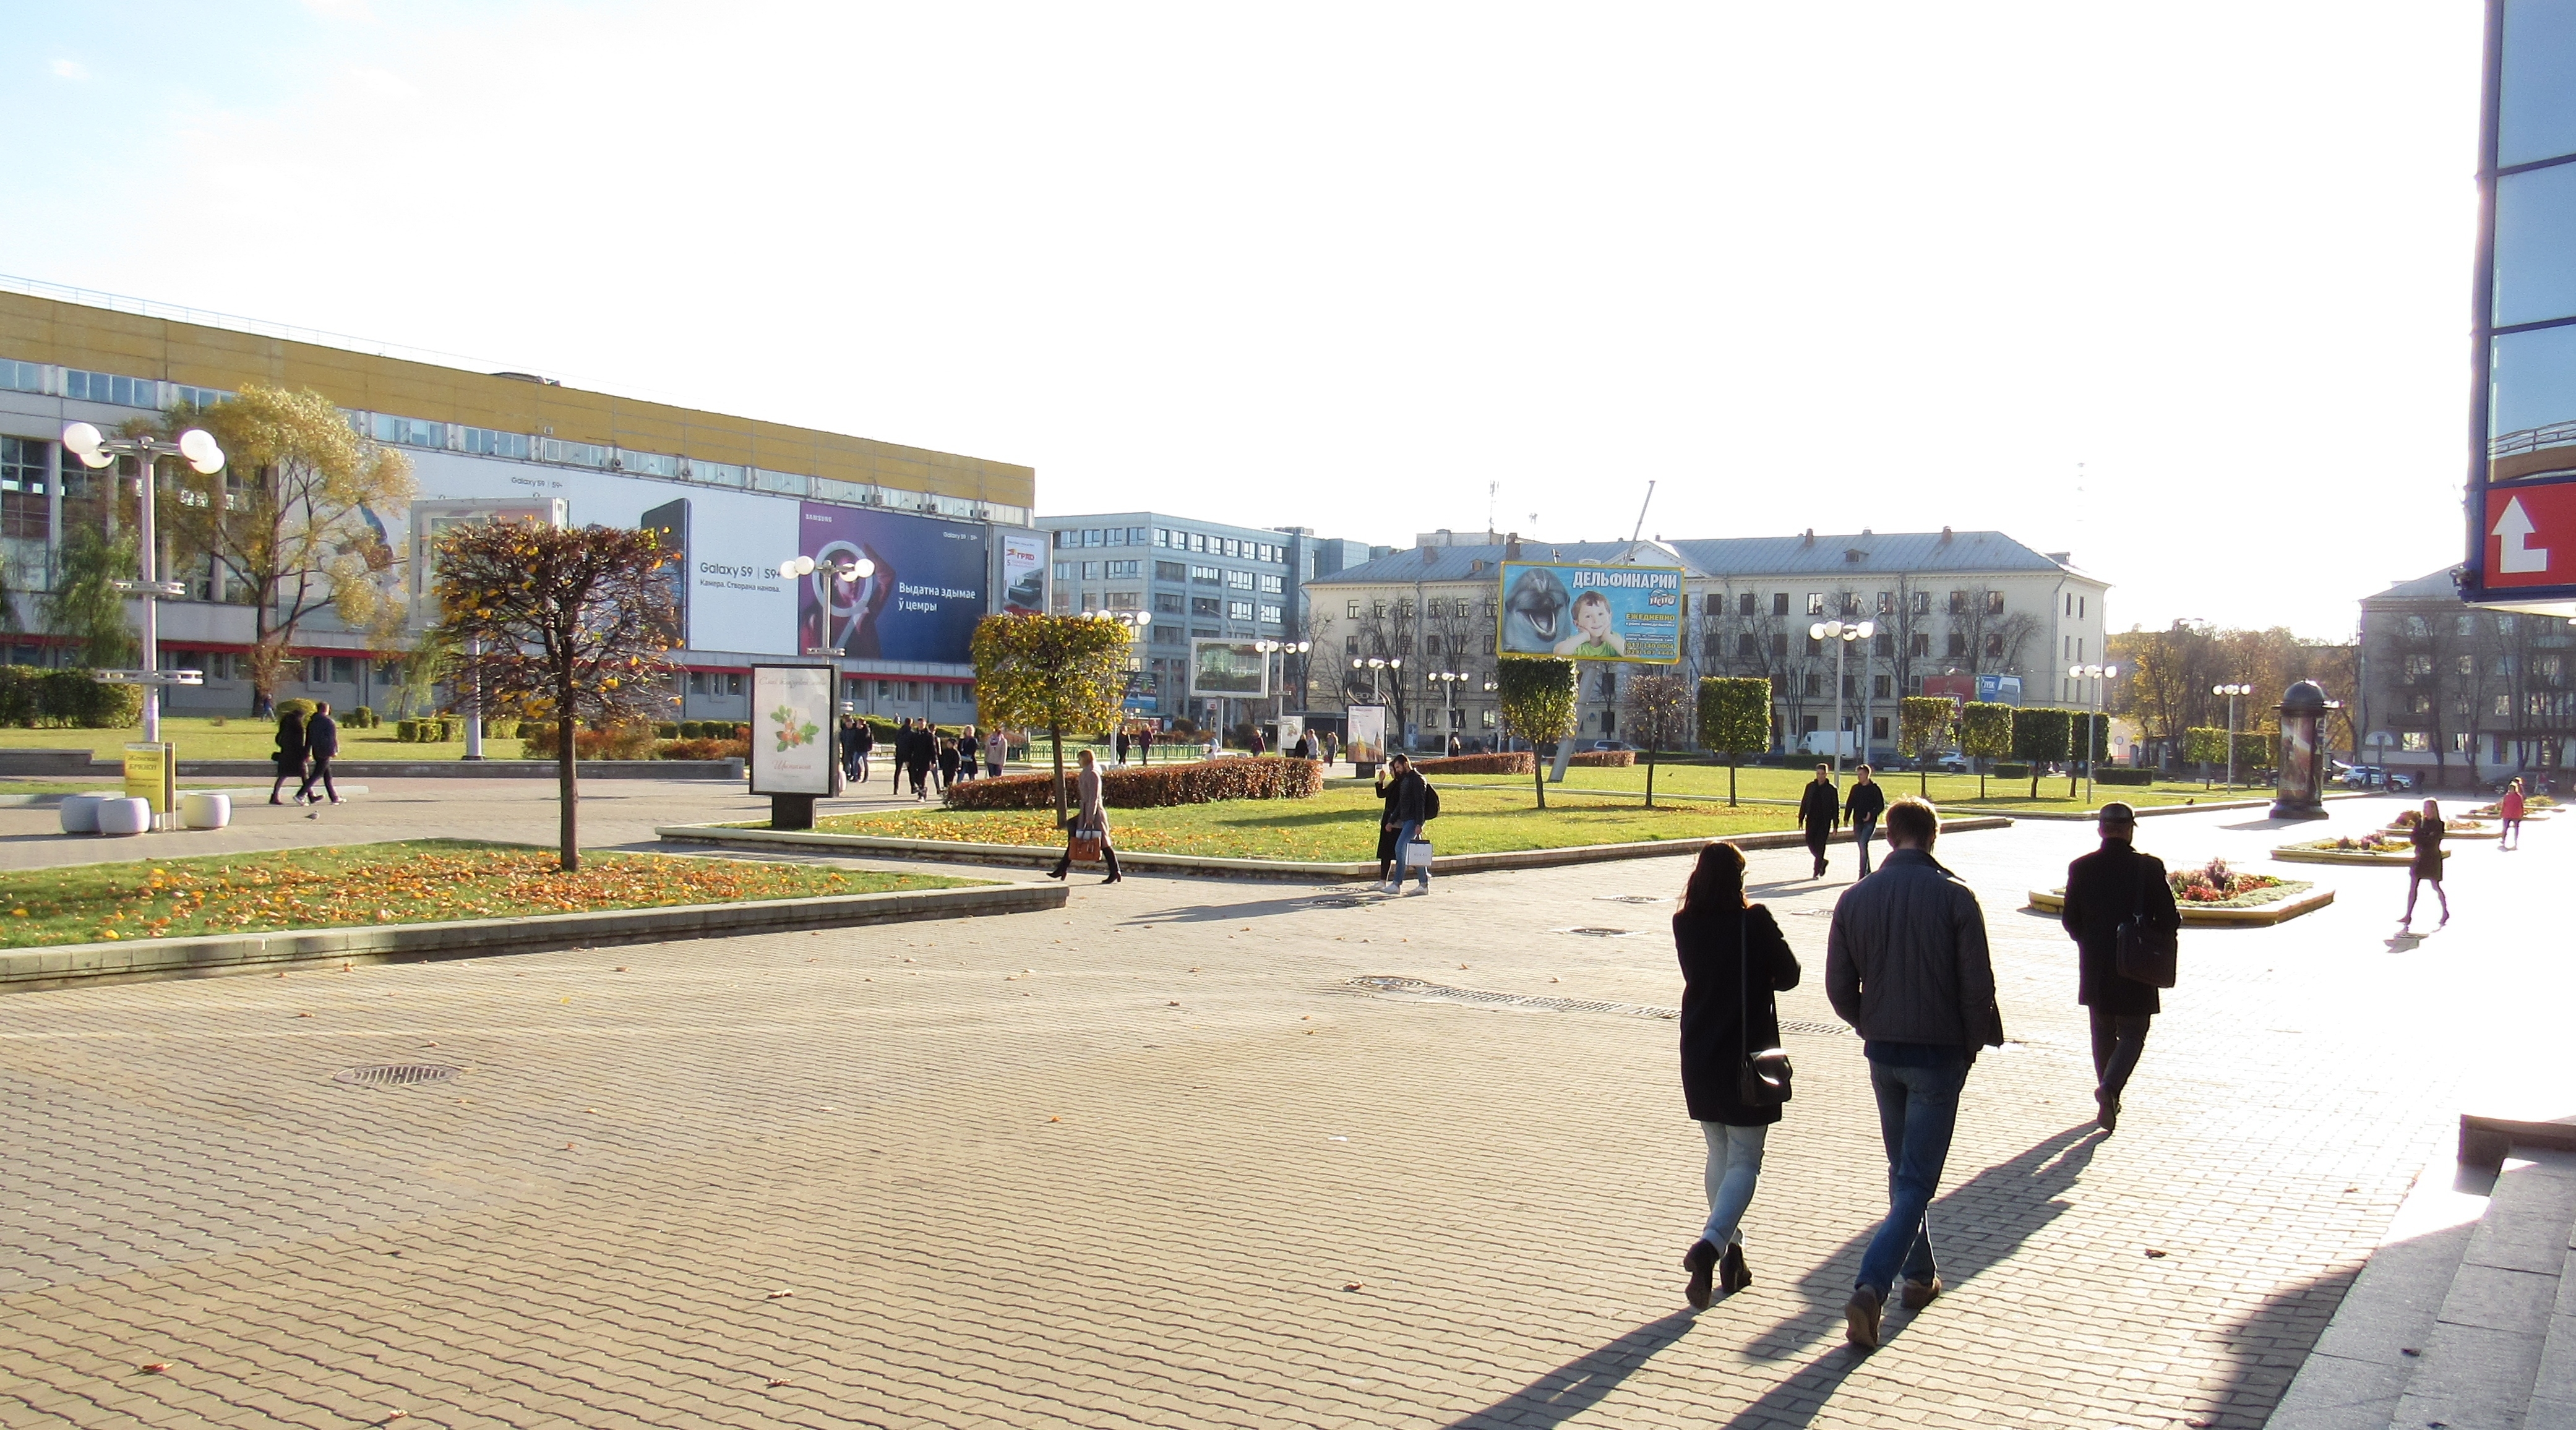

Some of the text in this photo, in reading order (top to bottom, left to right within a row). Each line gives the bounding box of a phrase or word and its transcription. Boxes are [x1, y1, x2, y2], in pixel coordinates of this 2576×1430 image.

[511, 477, 536, 487] Galaxy
[805, 514, 832, 523] SAMSUNG
[700, 562, 739, 578] Galaxy
[741, 566, 753, 577] S9
[700, 579, 726, 588] Камера.
[727, 581, 756, 591] Створана
[1572, 571, 1678, 589] ДЕЛЬФИНАРИЙ
[899, 582, 976, 599] Выдатна здымае
[898, 597, 938, 613] ў цемры
